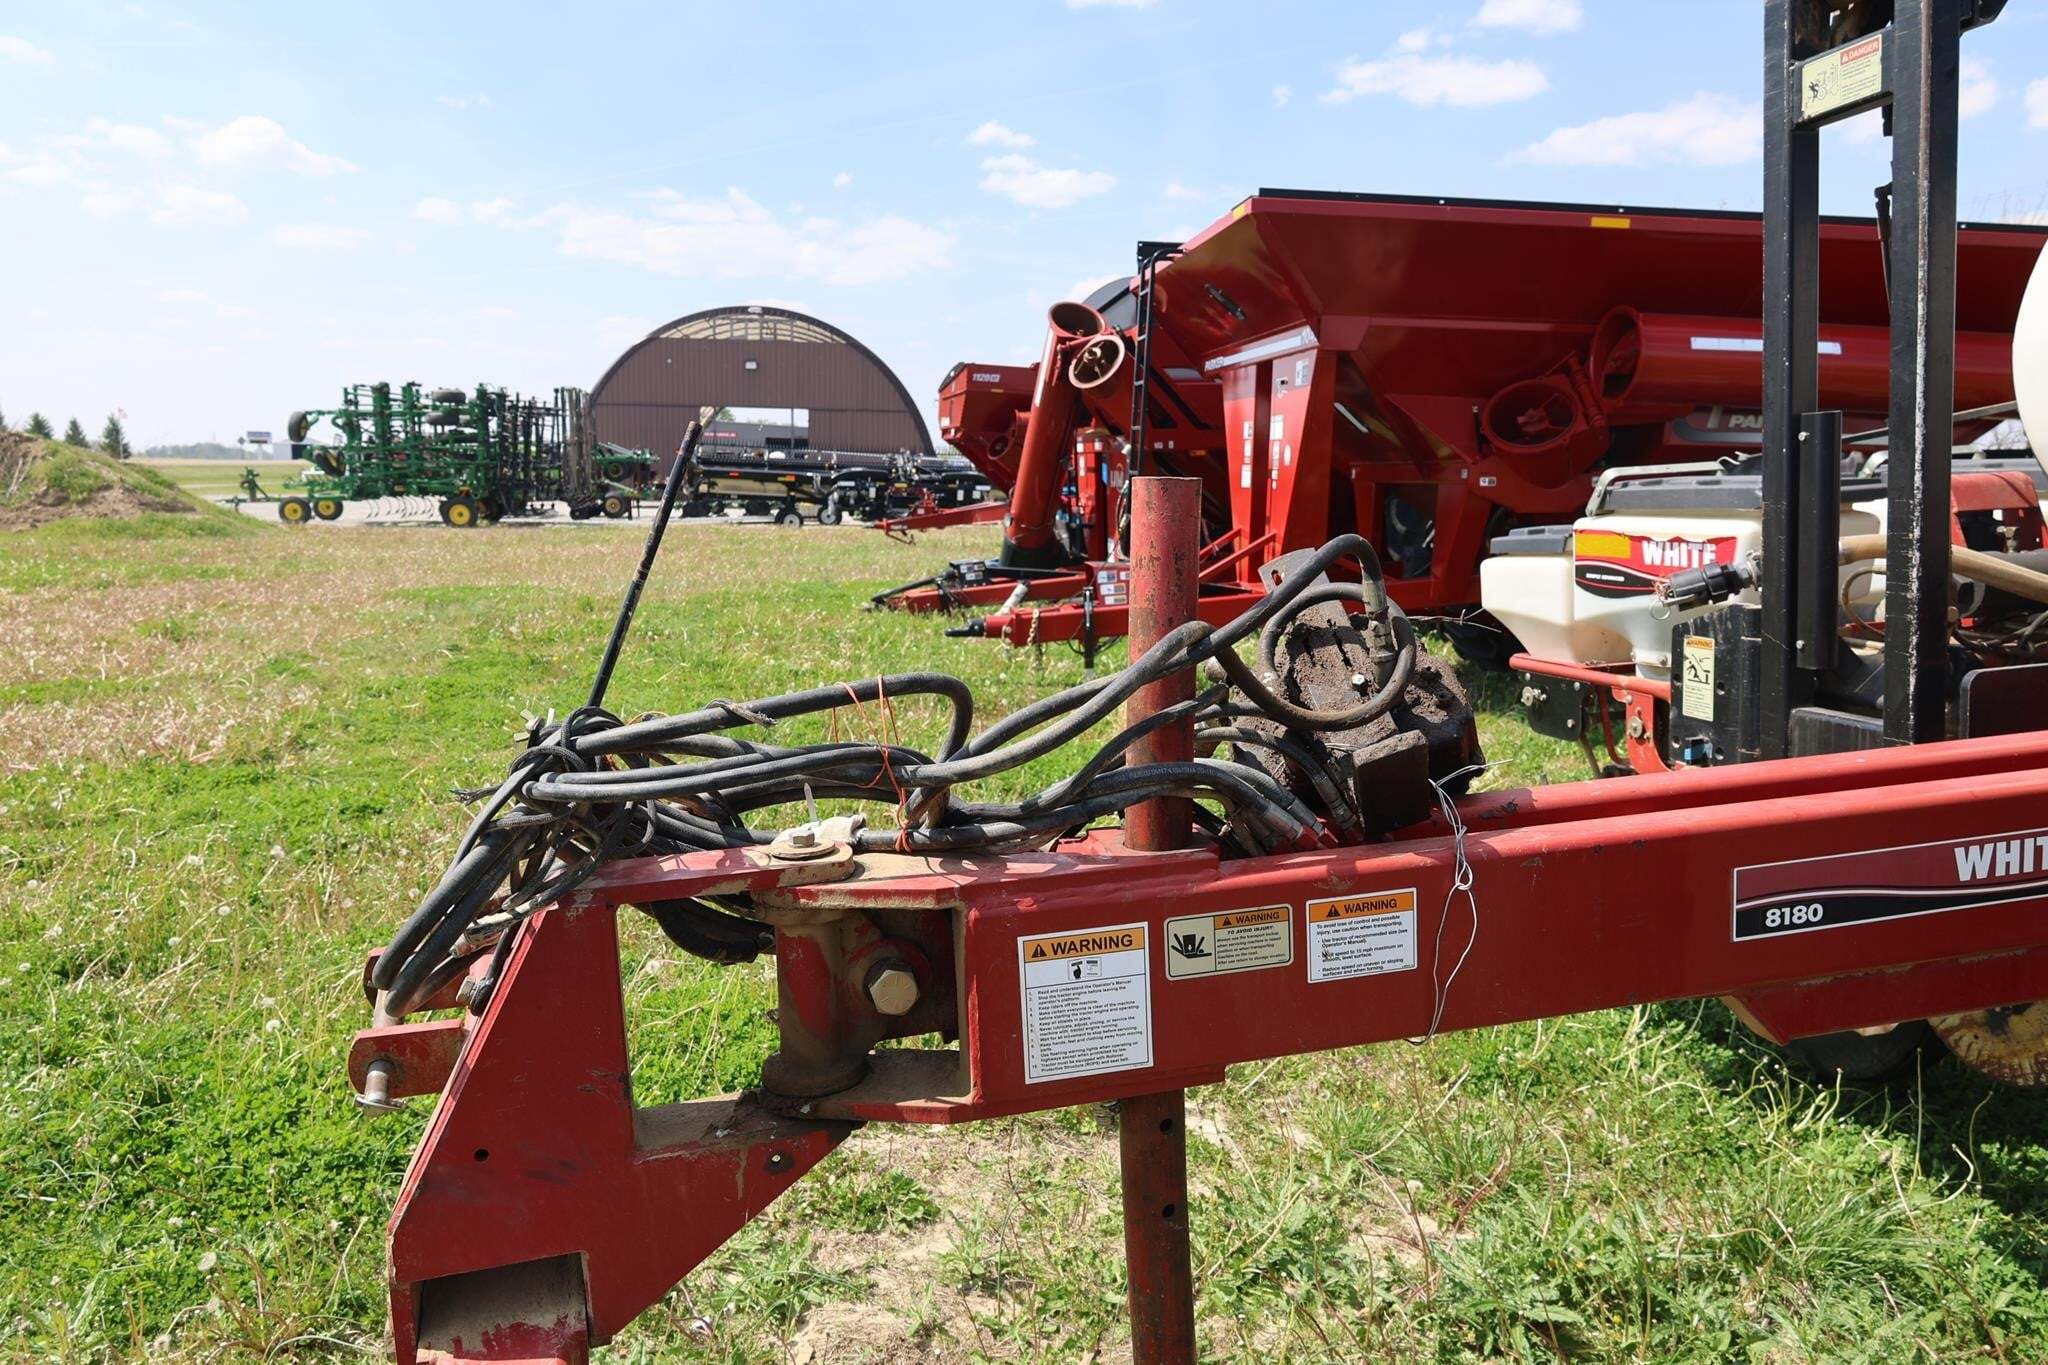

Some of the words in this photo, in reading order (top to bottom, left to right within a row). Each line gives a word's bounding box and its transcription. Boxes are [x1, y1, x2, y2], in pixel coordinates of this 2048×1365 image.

[1848, 42, 1878, 58] DANGER
[1641, 541, 1717, 568] WHITE
[1344, 898, 1396, 913] WARNING
[1236, 911, 1279, 924] WARNING
[1765, 903, 1824, 928] 8180
[1050, 933, 1132, 956] WARNING
